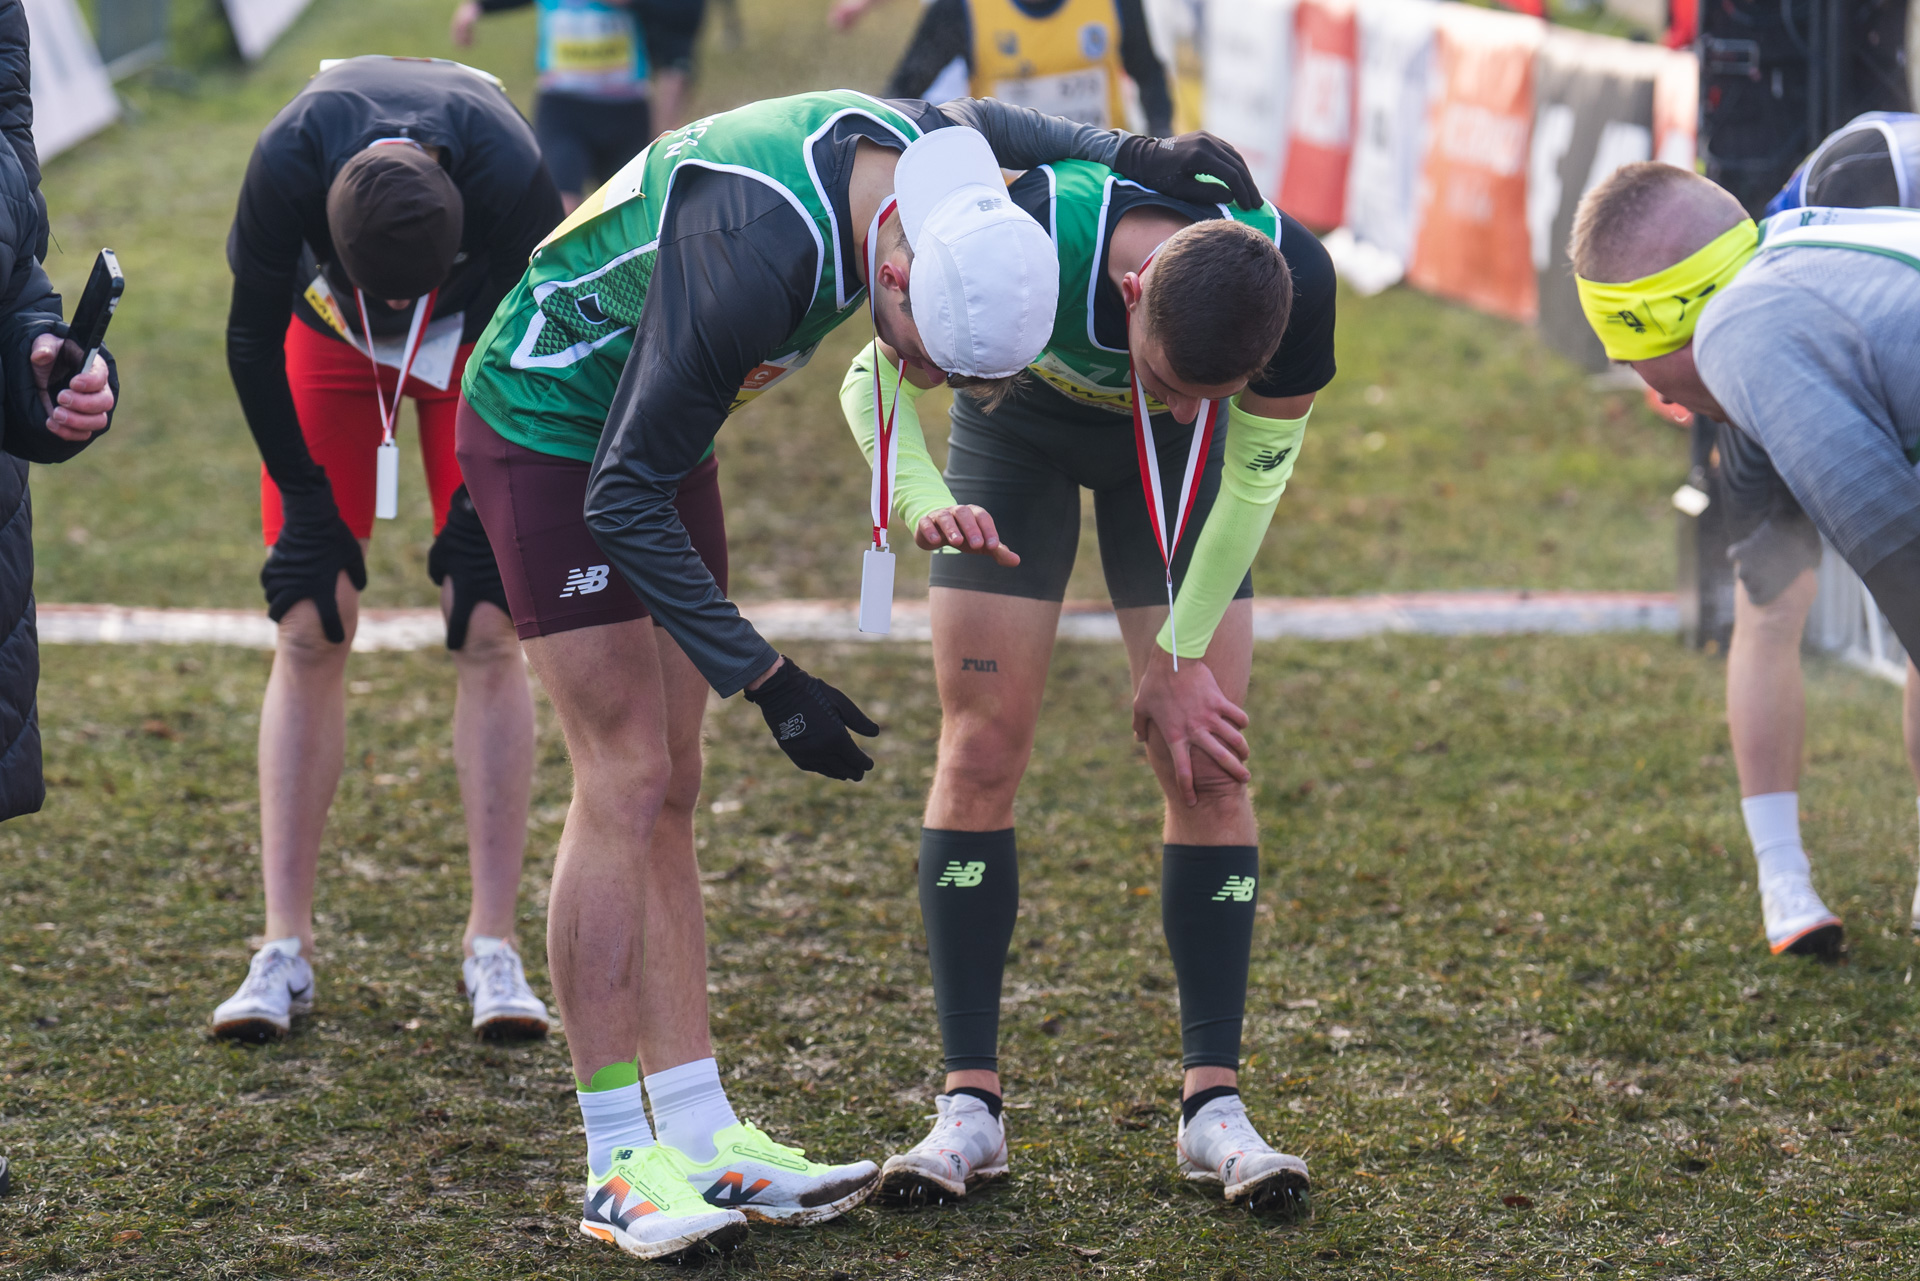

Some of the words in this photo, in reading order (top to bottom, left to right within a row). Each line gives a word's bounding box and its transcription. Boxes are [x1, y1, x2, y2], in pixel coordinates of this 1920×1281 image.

[559, 564, 610, 598] NB
[961, 658, 998, 673] run
[778, 712, 807, 741] NB
[936, 860, 987, 888] NB
[1211, 875, 1256, 902] NB
[614, 1149, 634, 1161] NB
[590, 1175, 660, 1232] N
